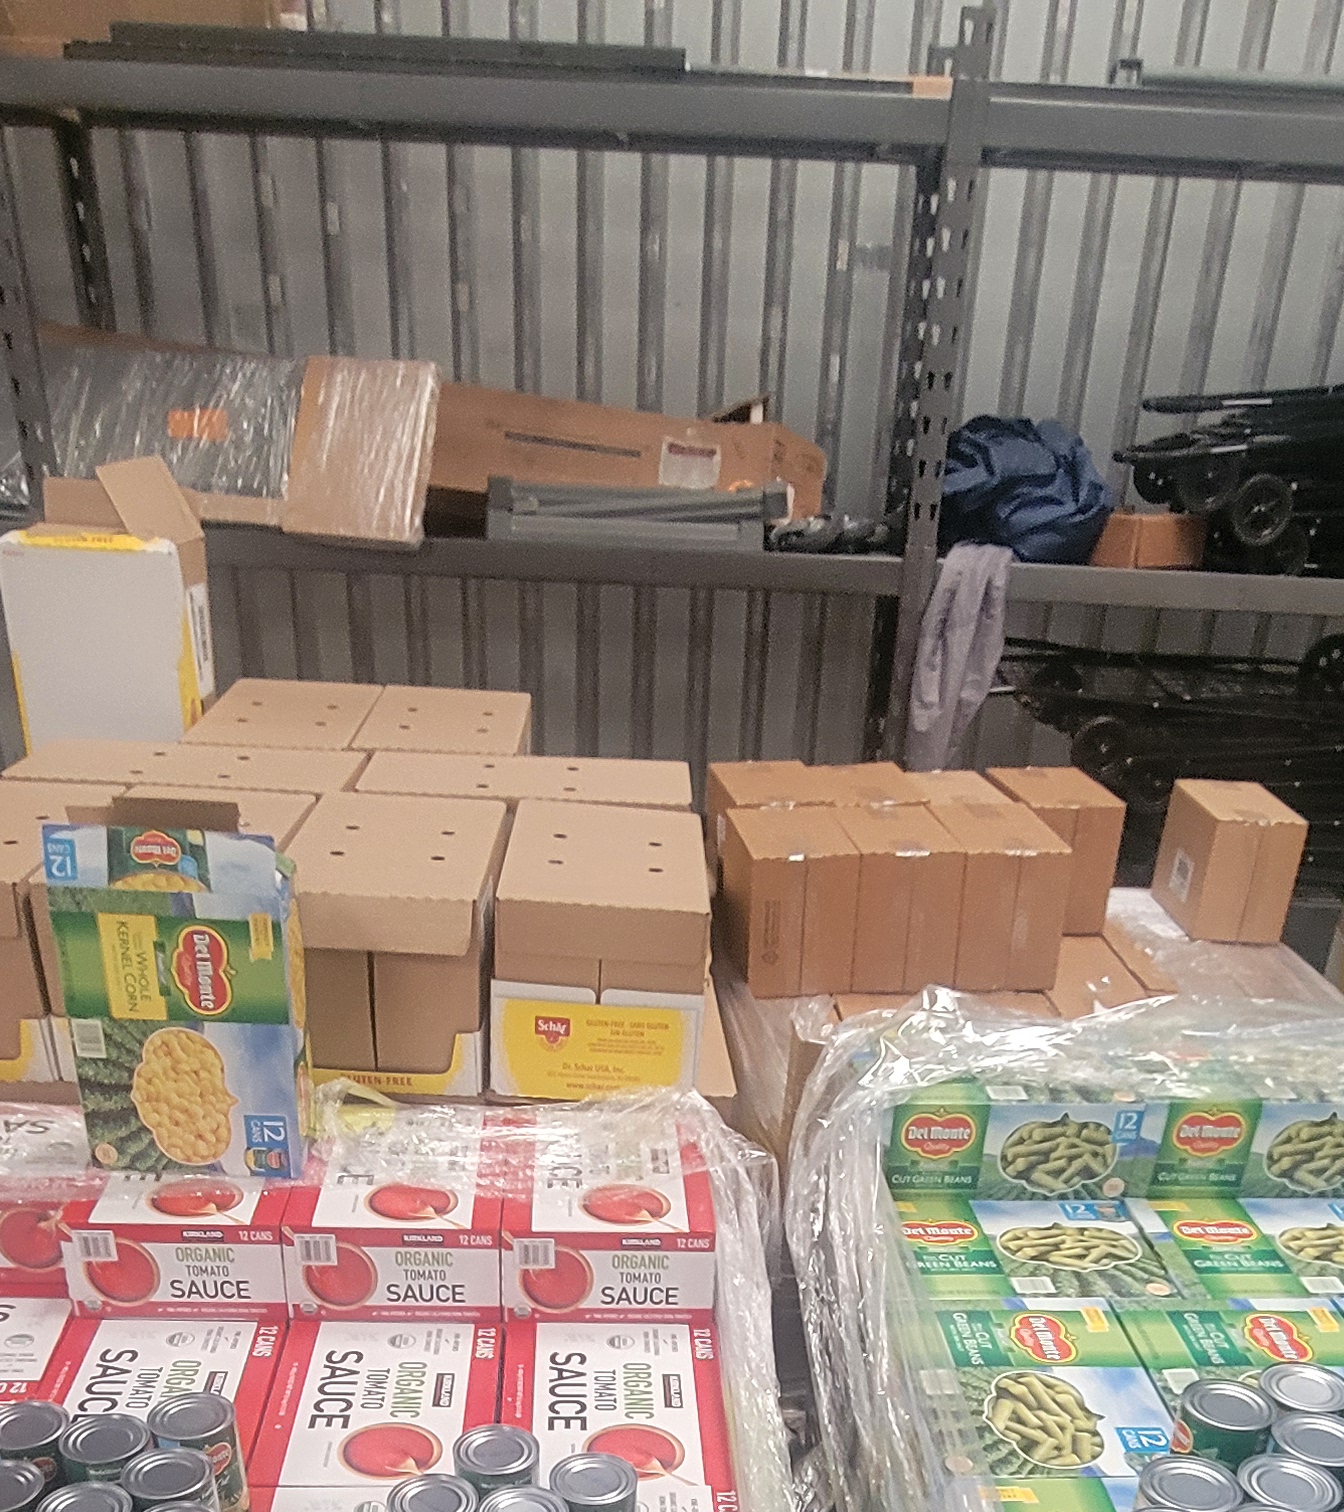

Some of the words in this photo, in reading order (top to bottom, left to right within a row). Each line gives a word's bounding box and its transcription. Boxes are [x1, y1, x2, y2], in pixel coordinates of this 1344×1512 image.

[116, 920, 134, 970] KERNEL
[192, 933, 210, 961] Del
[136, 952, 152, 1002] WHOLE
[195, 961, 216, 1009] Monte
[123, 972, 139, 1013] CORN
[1119, 1112, 1137, 1130] 12
[262, 1121, 286, 1142] 12
[907, 1126, 929, 1140] Del
[931, 1126, 971, 1141] Monte
[1180, 1125, 1201, 1139] Del
[1202, 1125, 1241, 1140] Monte
[891, 1174, 911, 1185] CUT
[912, 1174, 943, 1185] GREEN
[944, 1174, 972, 1185] BEANS
[925, 1225, 972, 1236] Monte
[175, 1247, 235, 1264] ORGANIC
[394, 1251, 454, 1268] ORGANIC
[611, 1254, 671, 1271] ORGANIC
[937, 1253, 967, 1263] CUT
[185, 1264, 230, 1278] TOMATO
[403, 1269, 447, 1282] TOMATO
[619, 1271, 663, 1284] TOMATO
[169, 1279, 253, 1300] SAUCE
[385, 1283, 467, 1304] SAUCE
[600, 1286, 680, 1306] SAUCE
[259, 1325, 279, 1336] 12
[477, 1327, 497, 1338] 12
[693, 1328, 709, 1339] 12
[975, 1331, 992, 1349] CUT
[1208, 1331, 1231, 1350] CUT
[252, 1334, 277, 1358] CANS
[474, 1337, 496, 1360] CANS
[694, 1338, 715, 1360] CANS
[1035, 1330, 1062, 1361] Monte
[10, 1382, 28, 1394] 12
[125, 1367, 162, 1409] TOMATO
[307, 1350, 365, 1430] SAUCE
[360, 1368, 391, 1411] TOMATO
[389, 1361, 428, 1419] ORGANIC
[547, 1351, 588, 1431] SAUCE
[593, 1369, 618, 1412] TOMATO
[622, 1362, 656, 1420] ORGANIC
[1140, 1429, 1168, 1449] 12
[716, 1490, 736, 1503] 12
